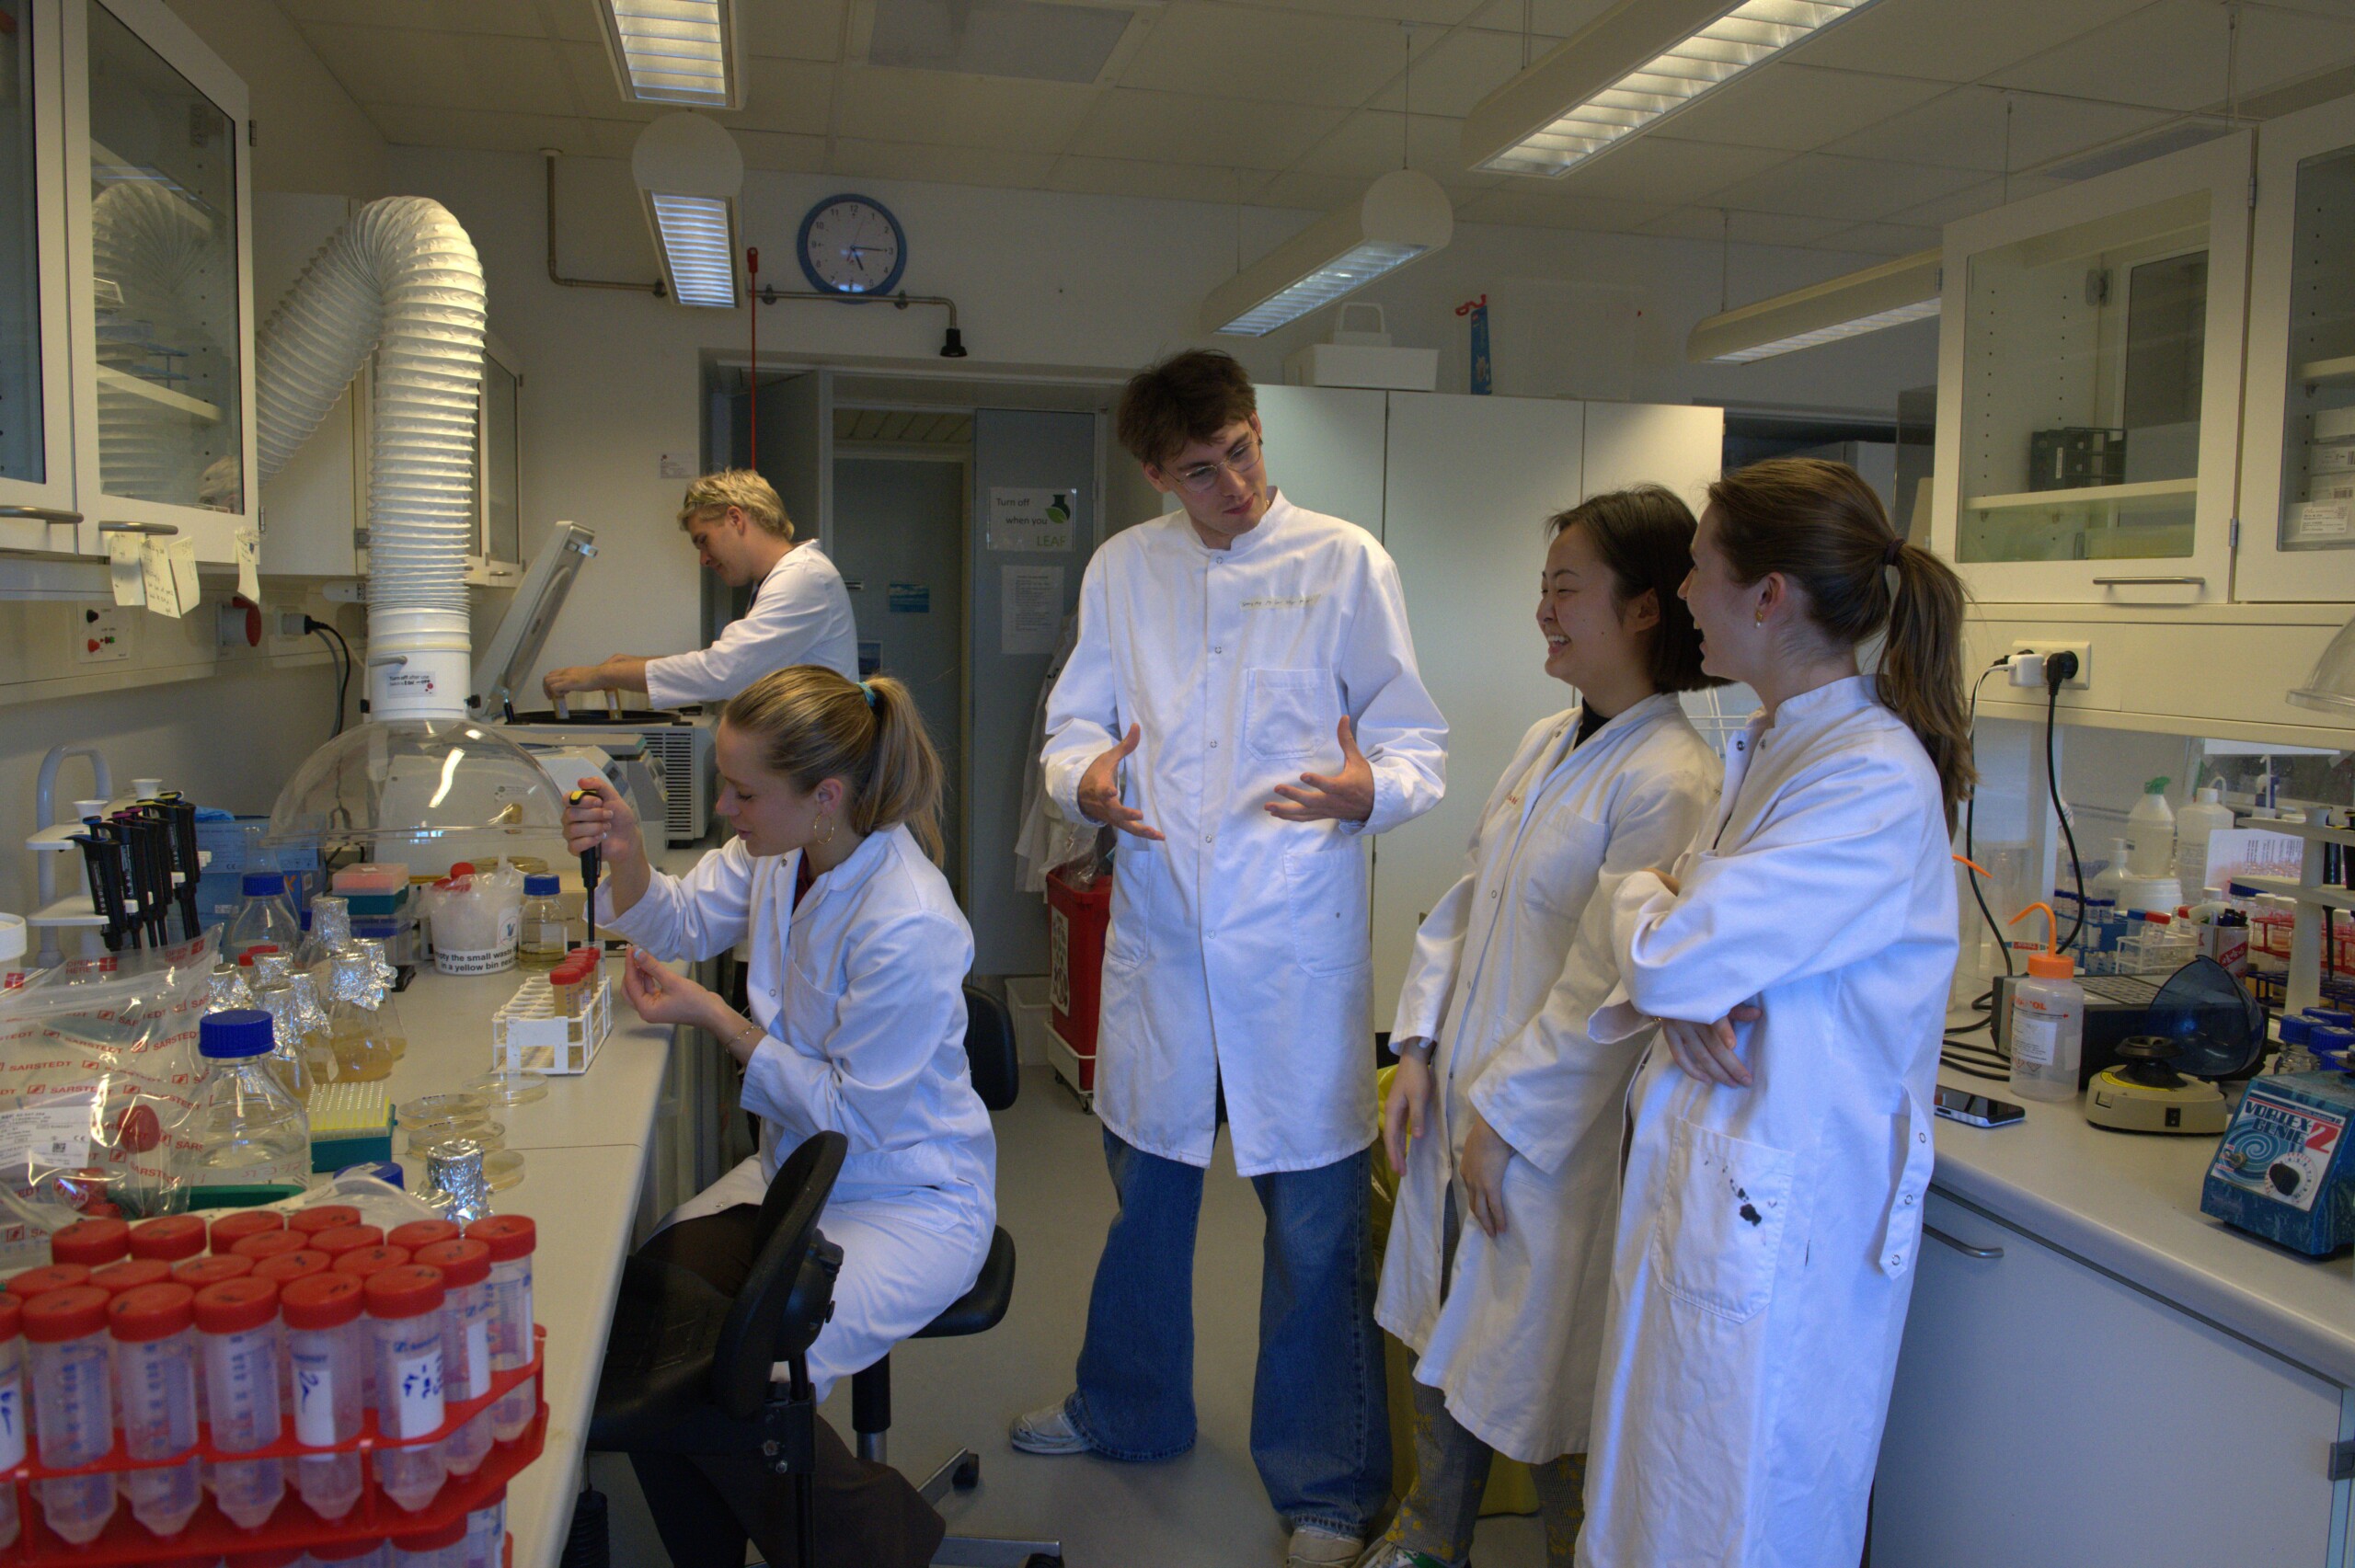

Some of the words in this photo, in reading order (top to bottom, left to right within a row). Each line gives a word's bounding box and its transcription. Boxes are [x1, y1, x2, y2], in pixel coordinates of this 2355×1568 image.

[851, 204, 858, 212] 12
[868, 279, 875, 287] 5
[996, 498, 1016, 507] Turn
[1017, 498, 1029, 507] off
[1005, 516, 1029, 525] when
[1031, 518, 1048, 526] you
[1037, 535, 1066, 547] LEAF
[451, 954, 465, 962] the
[466, 953, 491, 962] small
[493, 948, 512, 959] waste
[65, 966, 92, 975] HERE
[454, 964, 484, 972] yellow
[486, 962, 499, 970] bin
[64, 1036, 123, 1055] SARSTEDT
[8, 1060, 73, 1072] SARSTEDT
[2253, 1118, 2309, 1145] GENIE
[2305, 1121, 2339, 1154] 2
